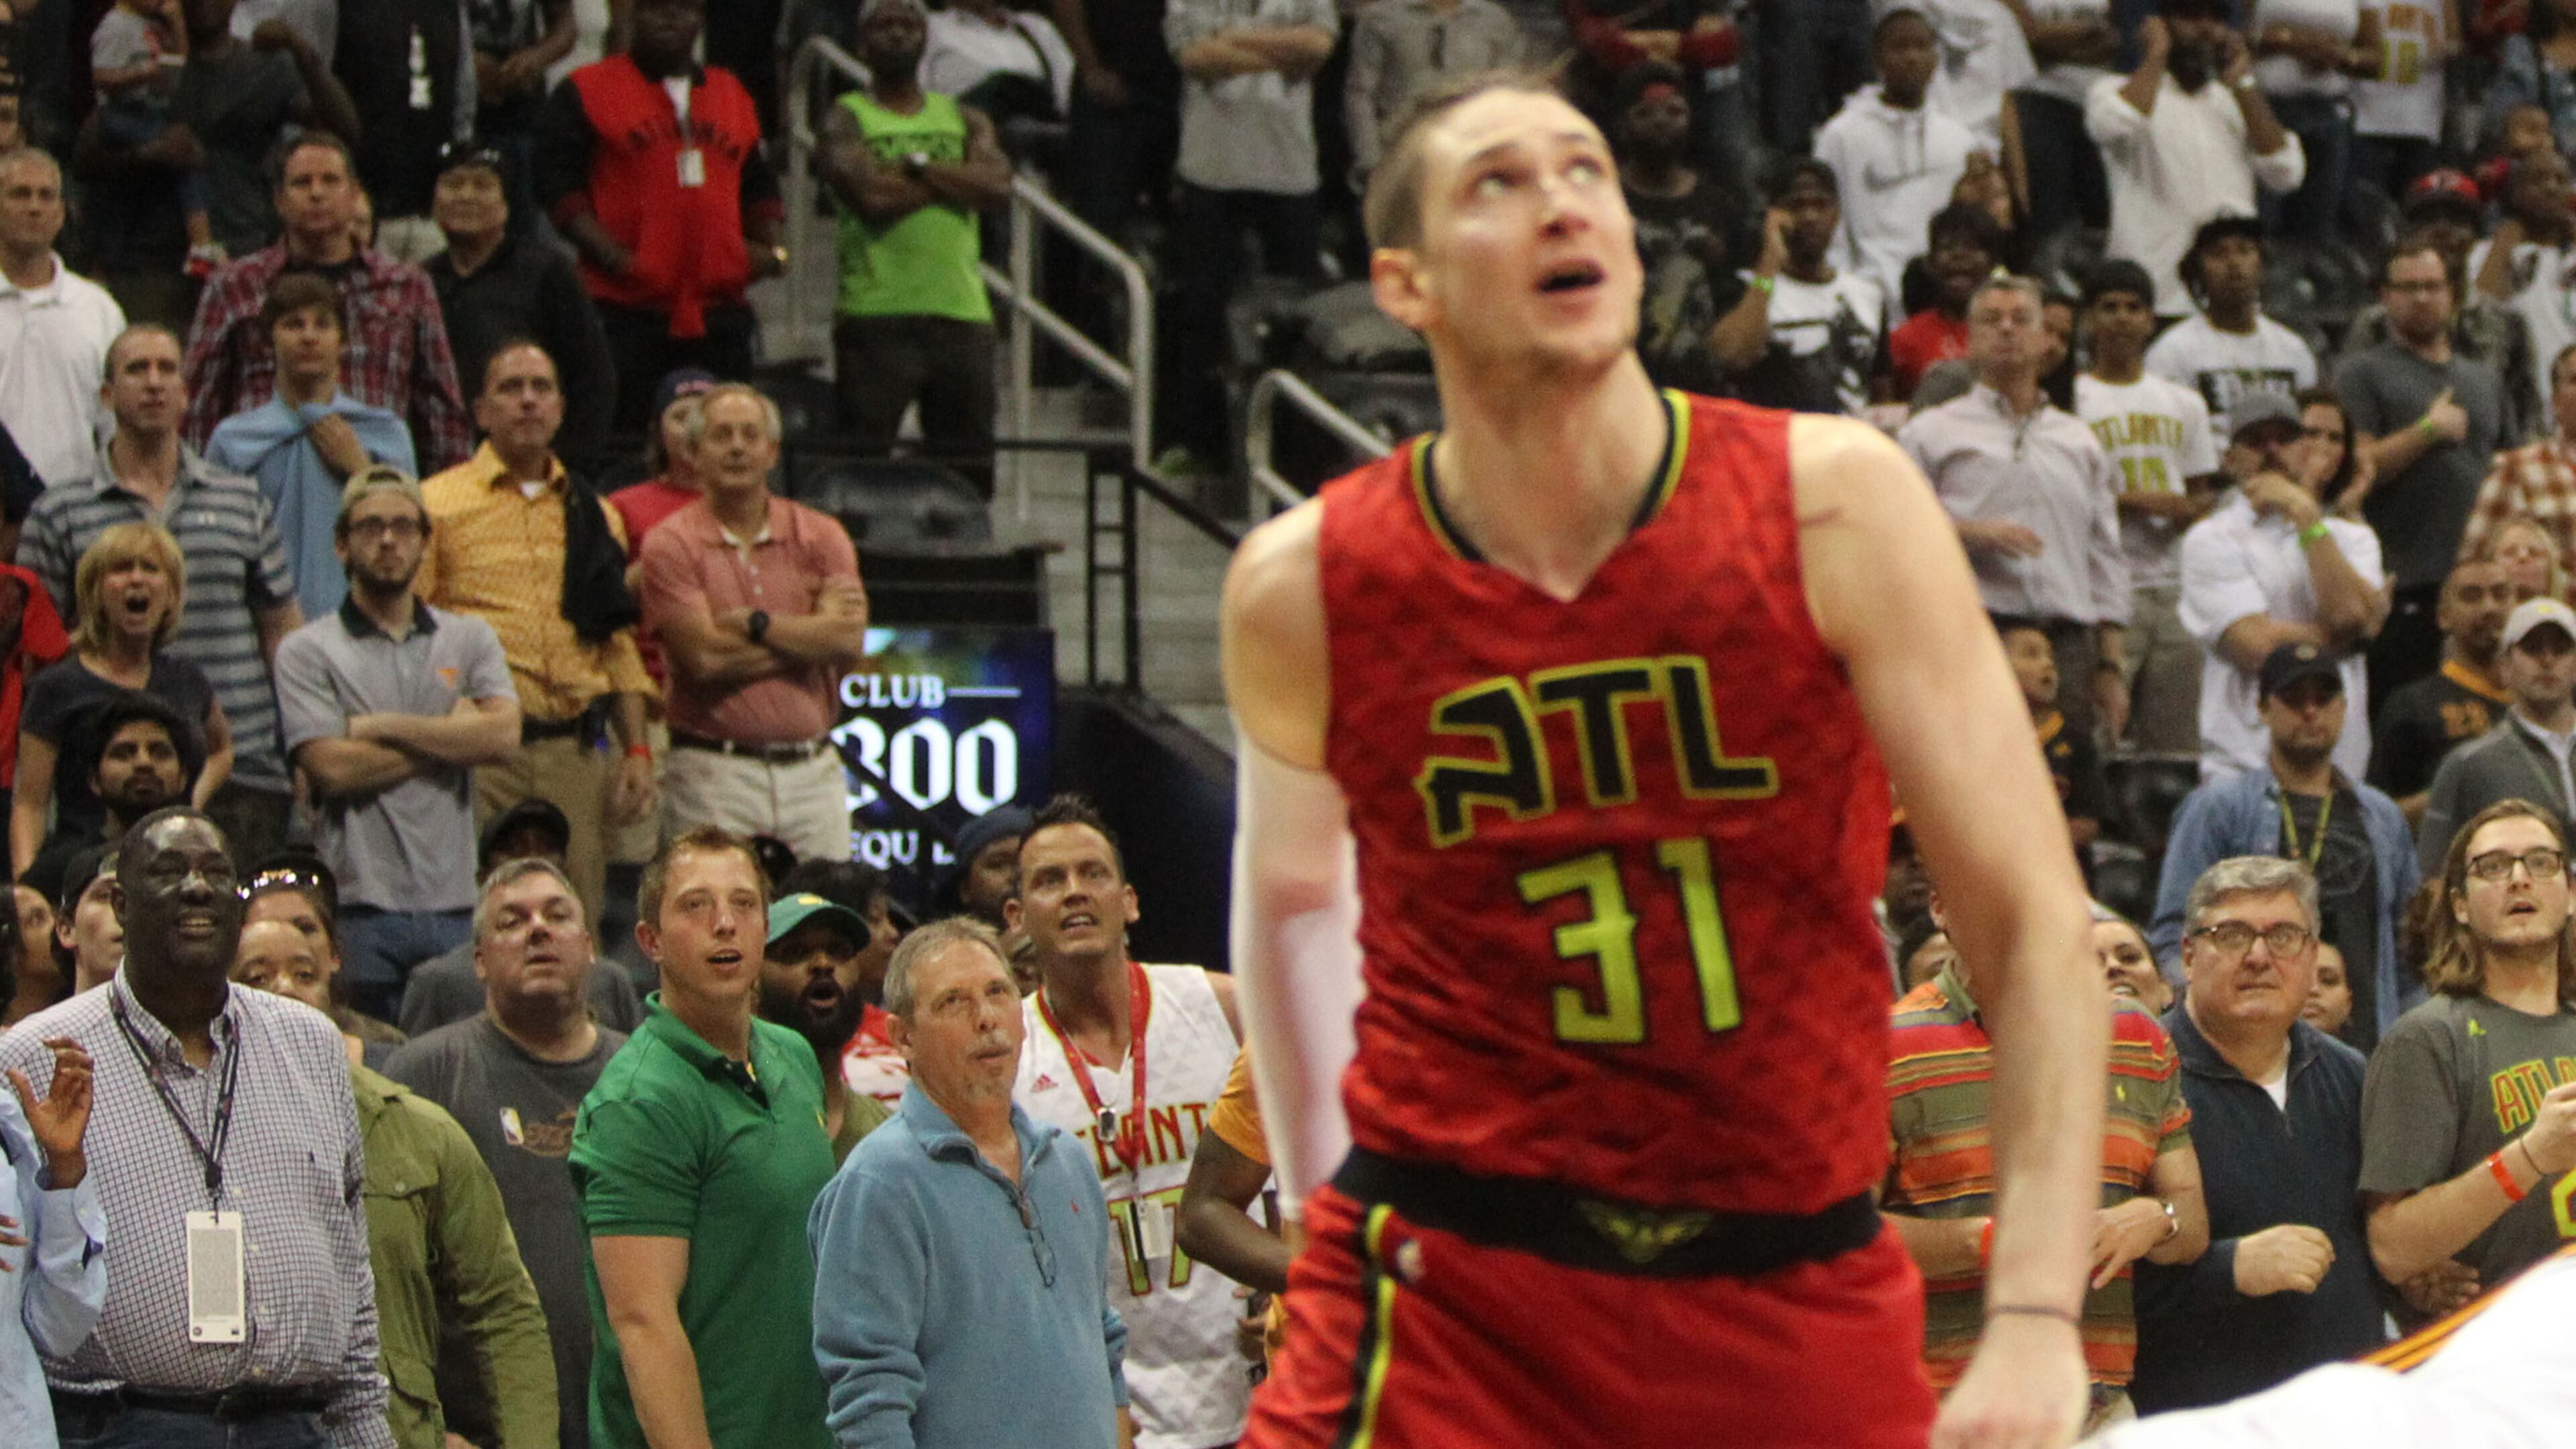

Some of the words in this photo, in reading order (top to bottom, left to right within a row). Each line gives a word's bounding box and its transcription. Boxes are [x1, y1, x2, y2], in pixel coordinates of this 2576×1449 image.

[839, 673, 946, 709] CLUB
[1412, 654, 1782, 849] ATL
[1516, 837, 1741, 1044] 31
